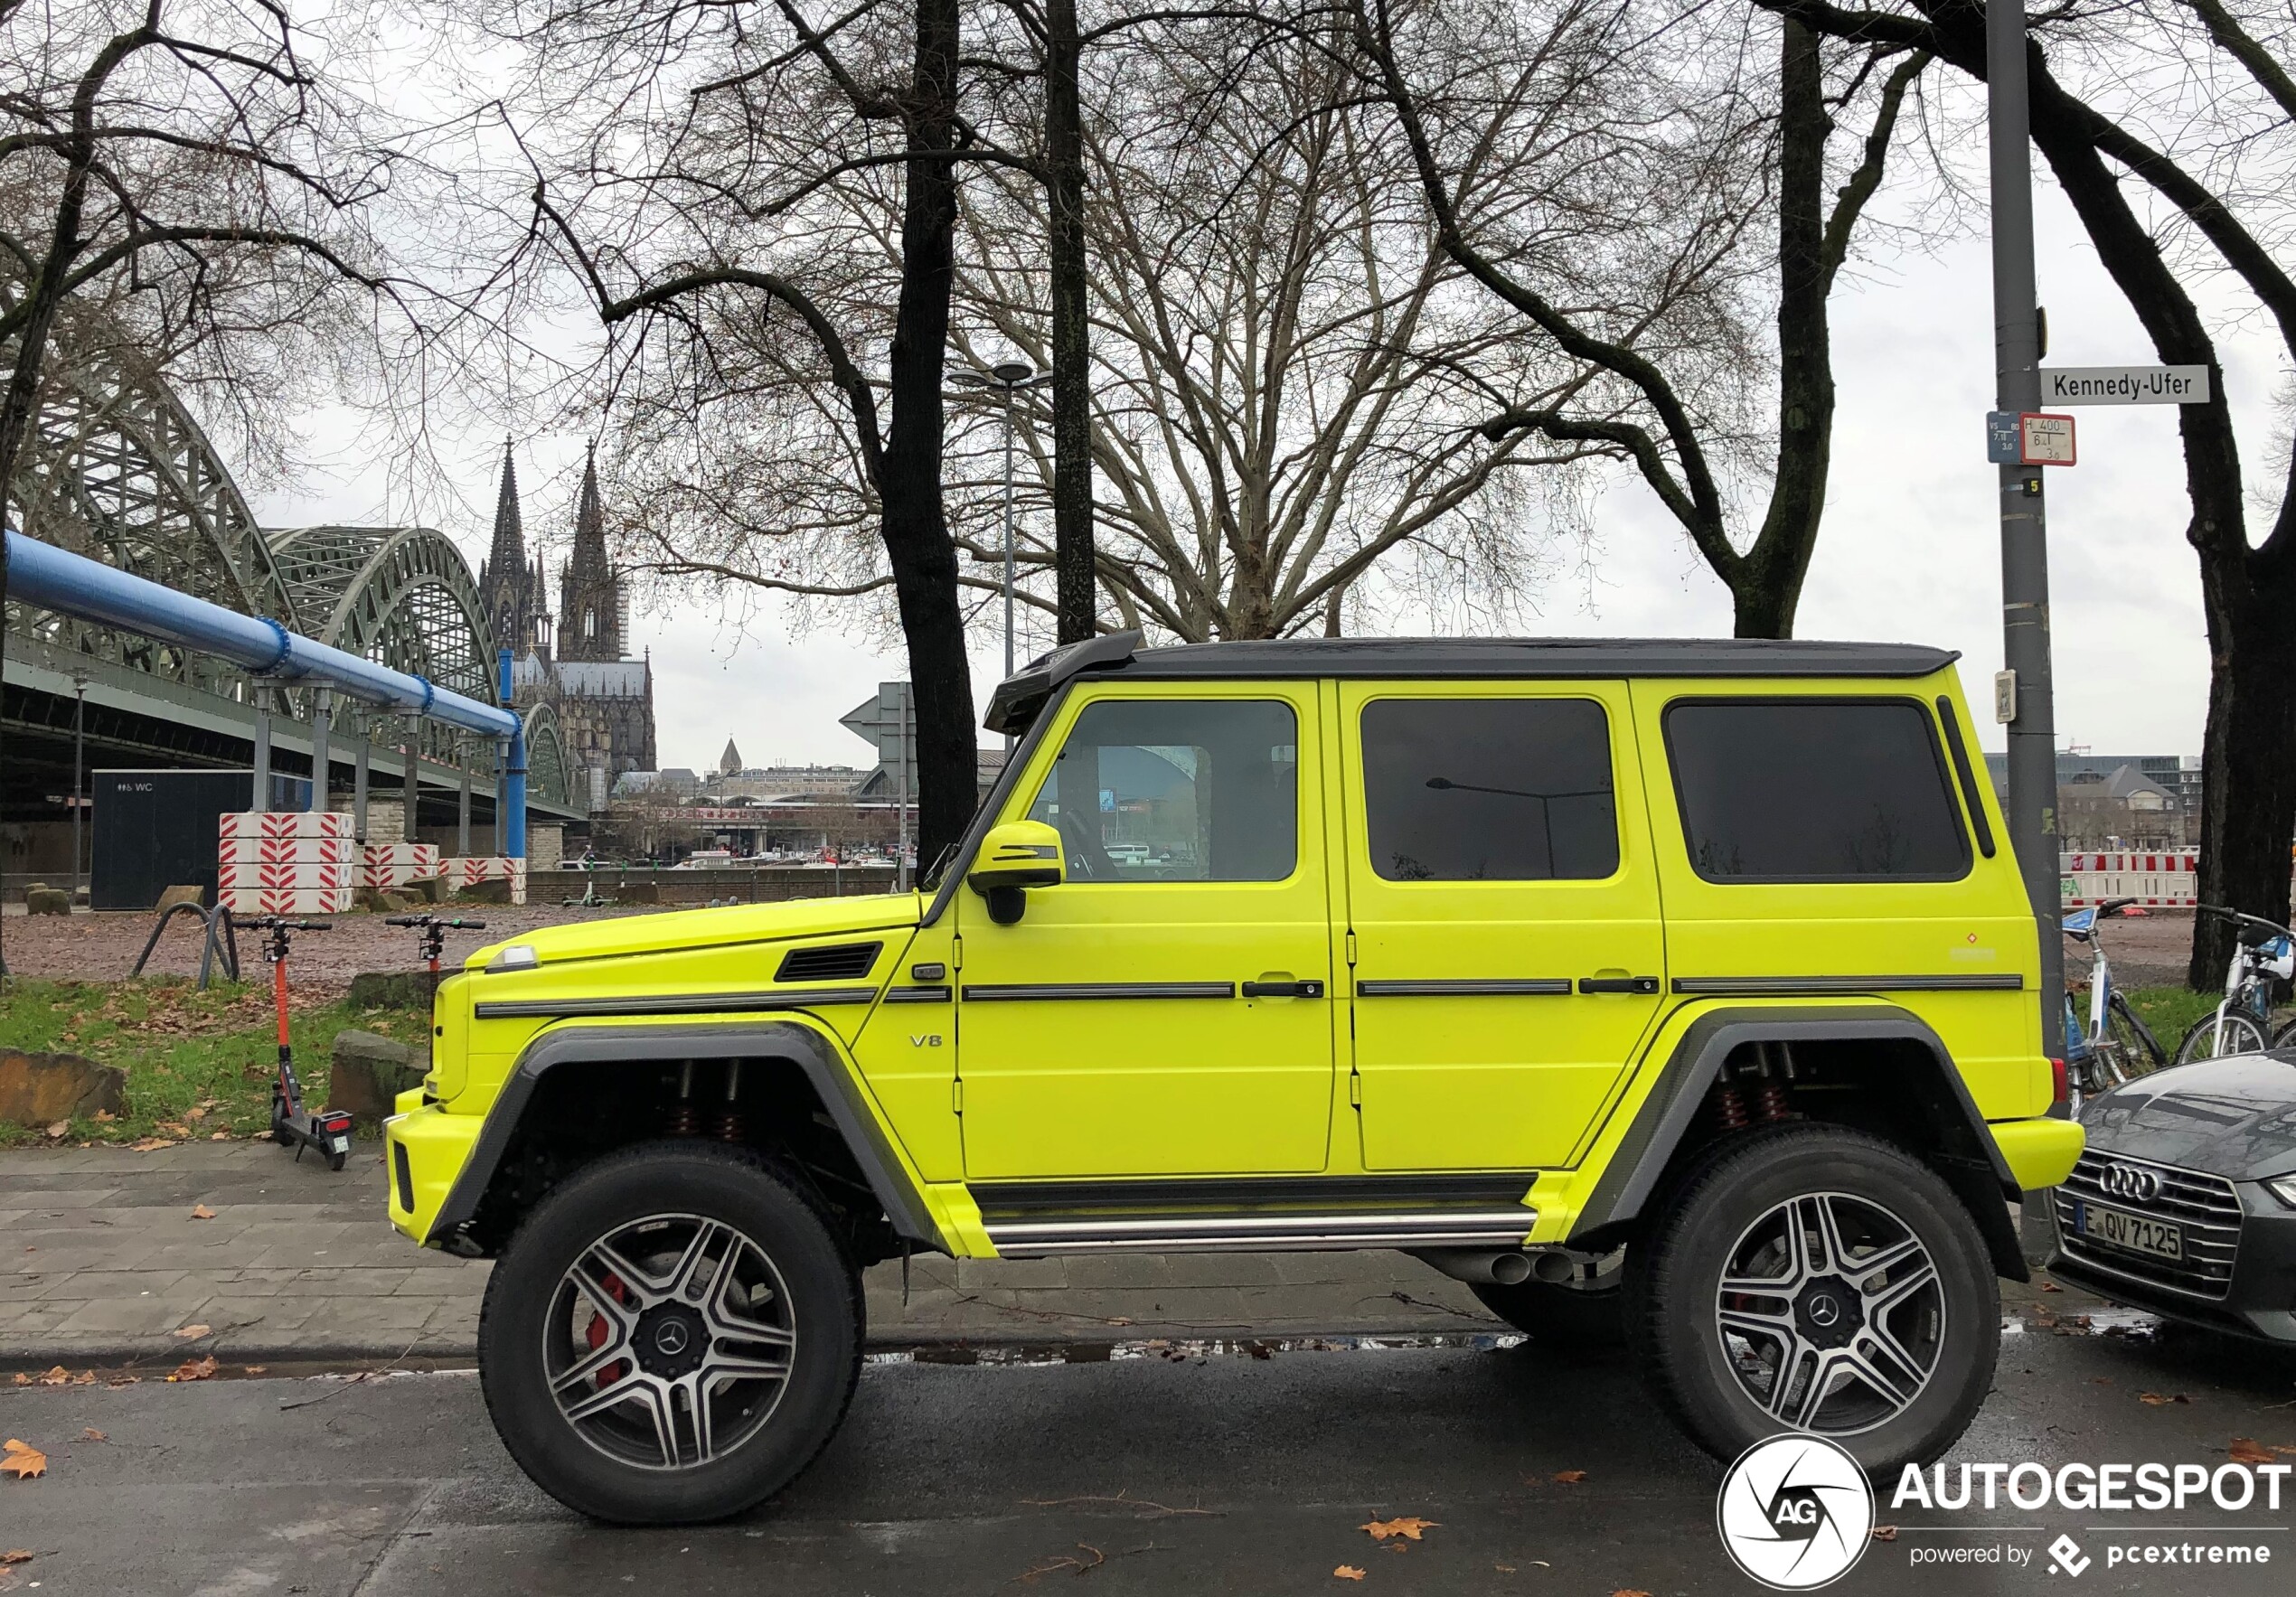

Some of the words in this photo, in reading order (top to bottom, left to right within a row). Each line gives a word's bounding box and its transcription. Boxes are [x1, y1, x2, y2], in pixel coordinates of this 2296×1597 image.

[2054, 373, 2191, 400] Kennedy-Ufer
[2025, 419, 2032, 429] H
[2040, 419, 2060, 431] 400
[2030, 480, 2039, 493] 5
[135, 783, 153, 792] WC
[910, 1034, 943, 1047] V8
[2084, 1207, 2095, 1234] E
[2105, 1212, 2127, 1242] QV
[2131, 1217, 2179, 1255] 7125
